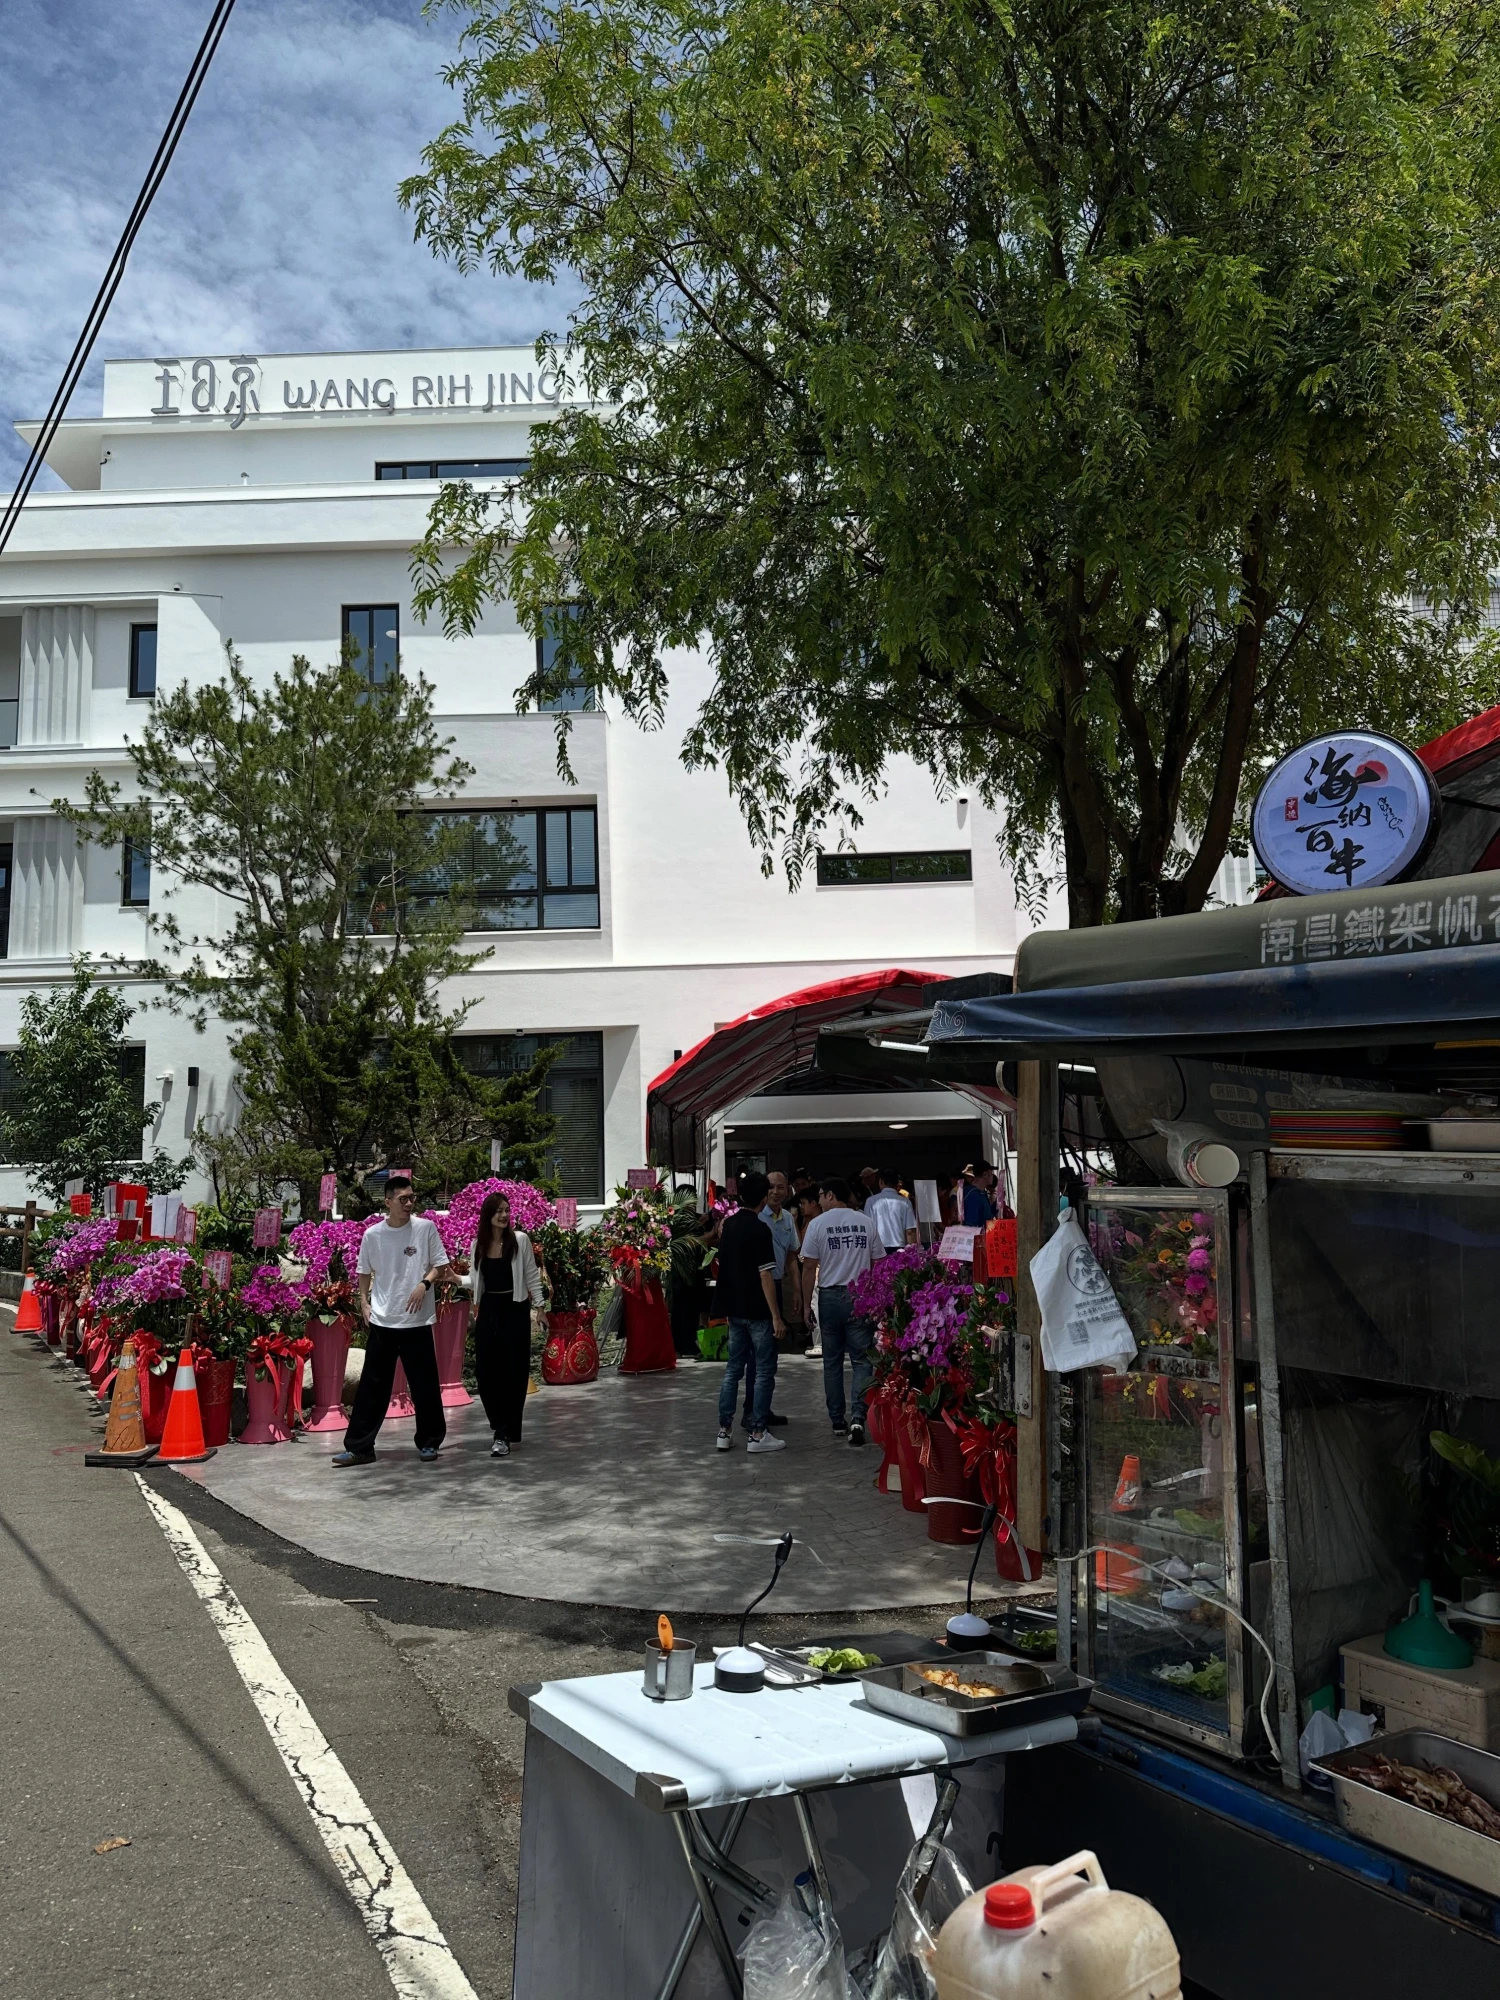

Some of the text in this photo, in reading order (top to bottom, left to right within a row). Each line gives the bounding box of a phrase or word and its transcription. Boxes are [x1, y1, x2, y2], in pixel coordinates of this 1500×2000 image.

[283, 376, 397, 415] WANG
[412, 373, 471, 406] RIH
[483, 370, 560, 413] JING
[1259, 894, 1500, 964] 南昌鐵架帆
[826, 1225, 867, 1235] 南投縣議員
[827, 1235, 867, 1250] 簡千翔
